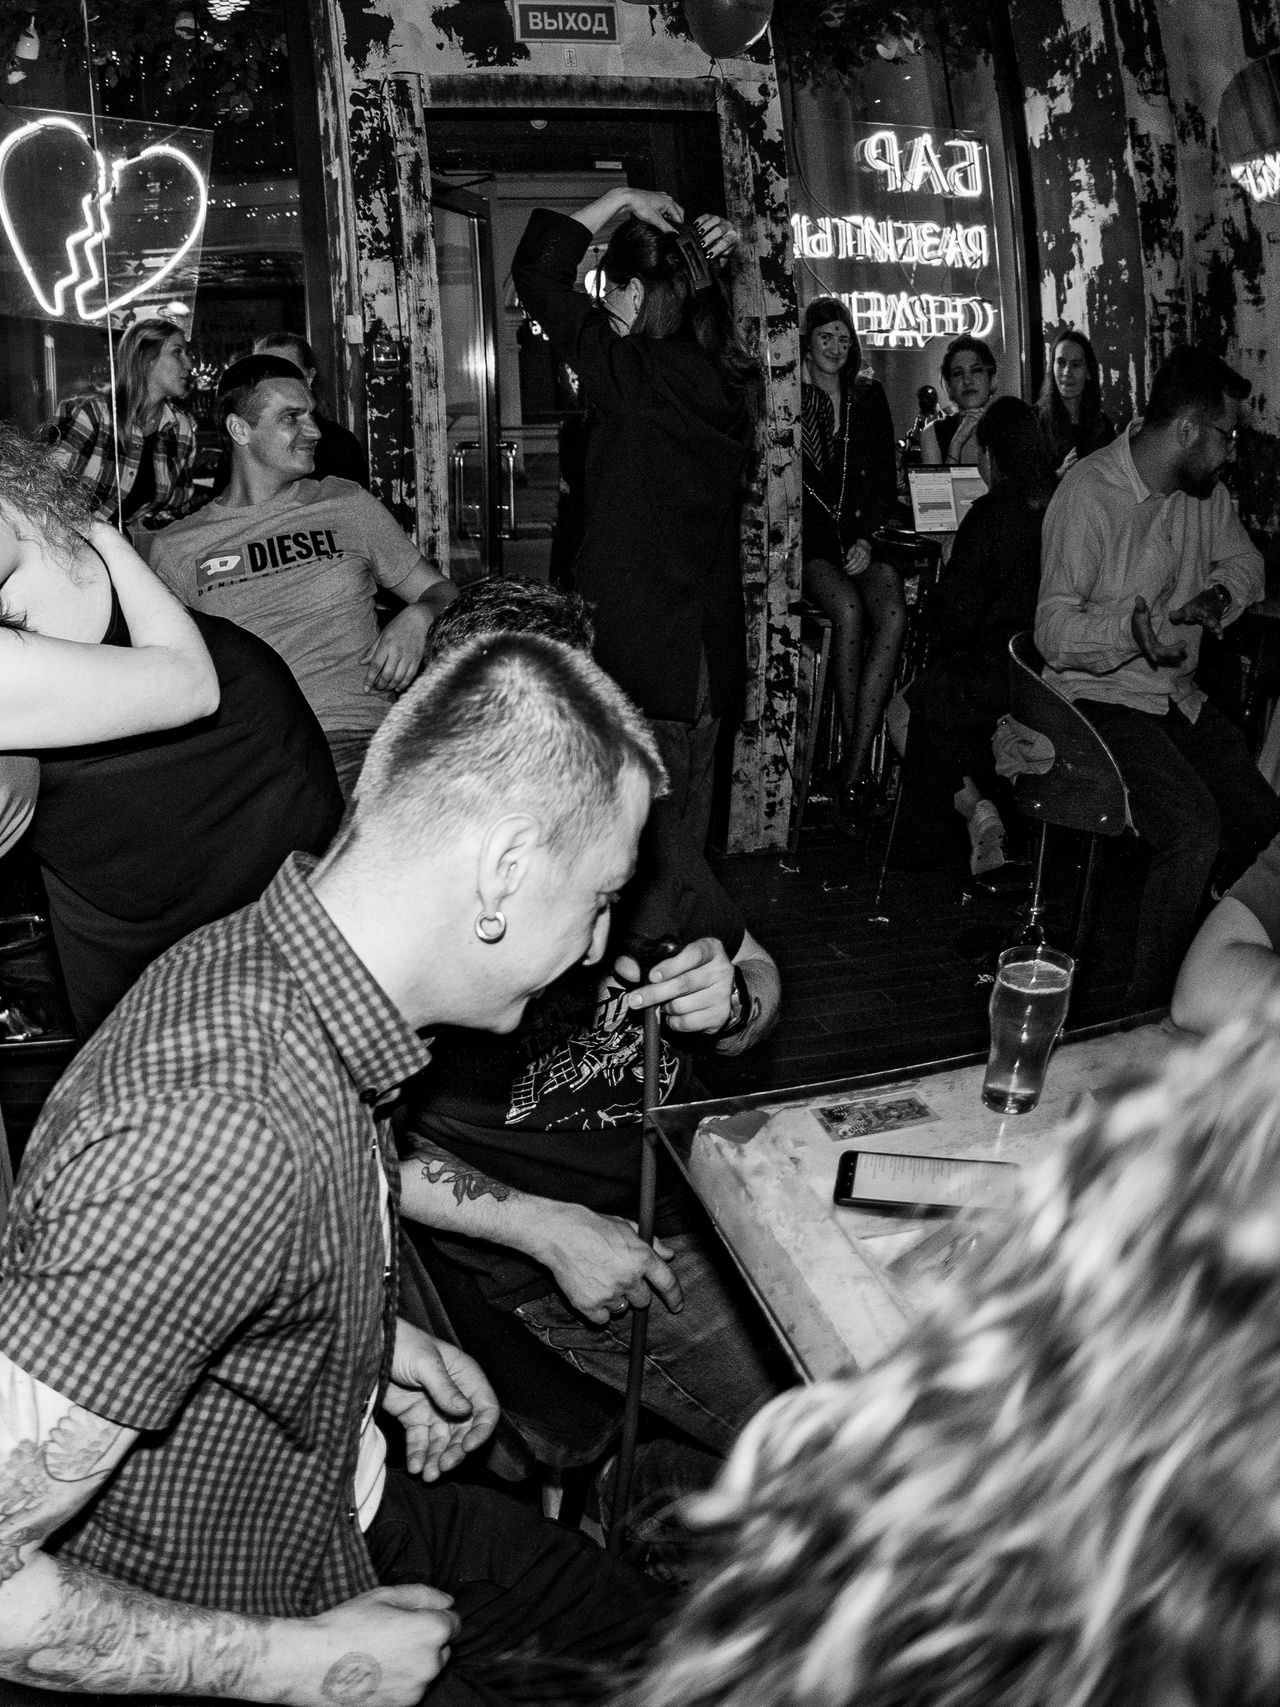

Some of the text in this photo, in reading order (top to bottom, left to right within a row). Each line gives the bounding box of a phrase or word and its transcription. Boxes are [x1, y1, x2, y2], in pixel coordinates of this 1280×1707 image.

[528, 11, 609, 35] ВЫХОД
[247, 529, 344, 573] DIESEL
[197, 577, 248, 597] DENIM
